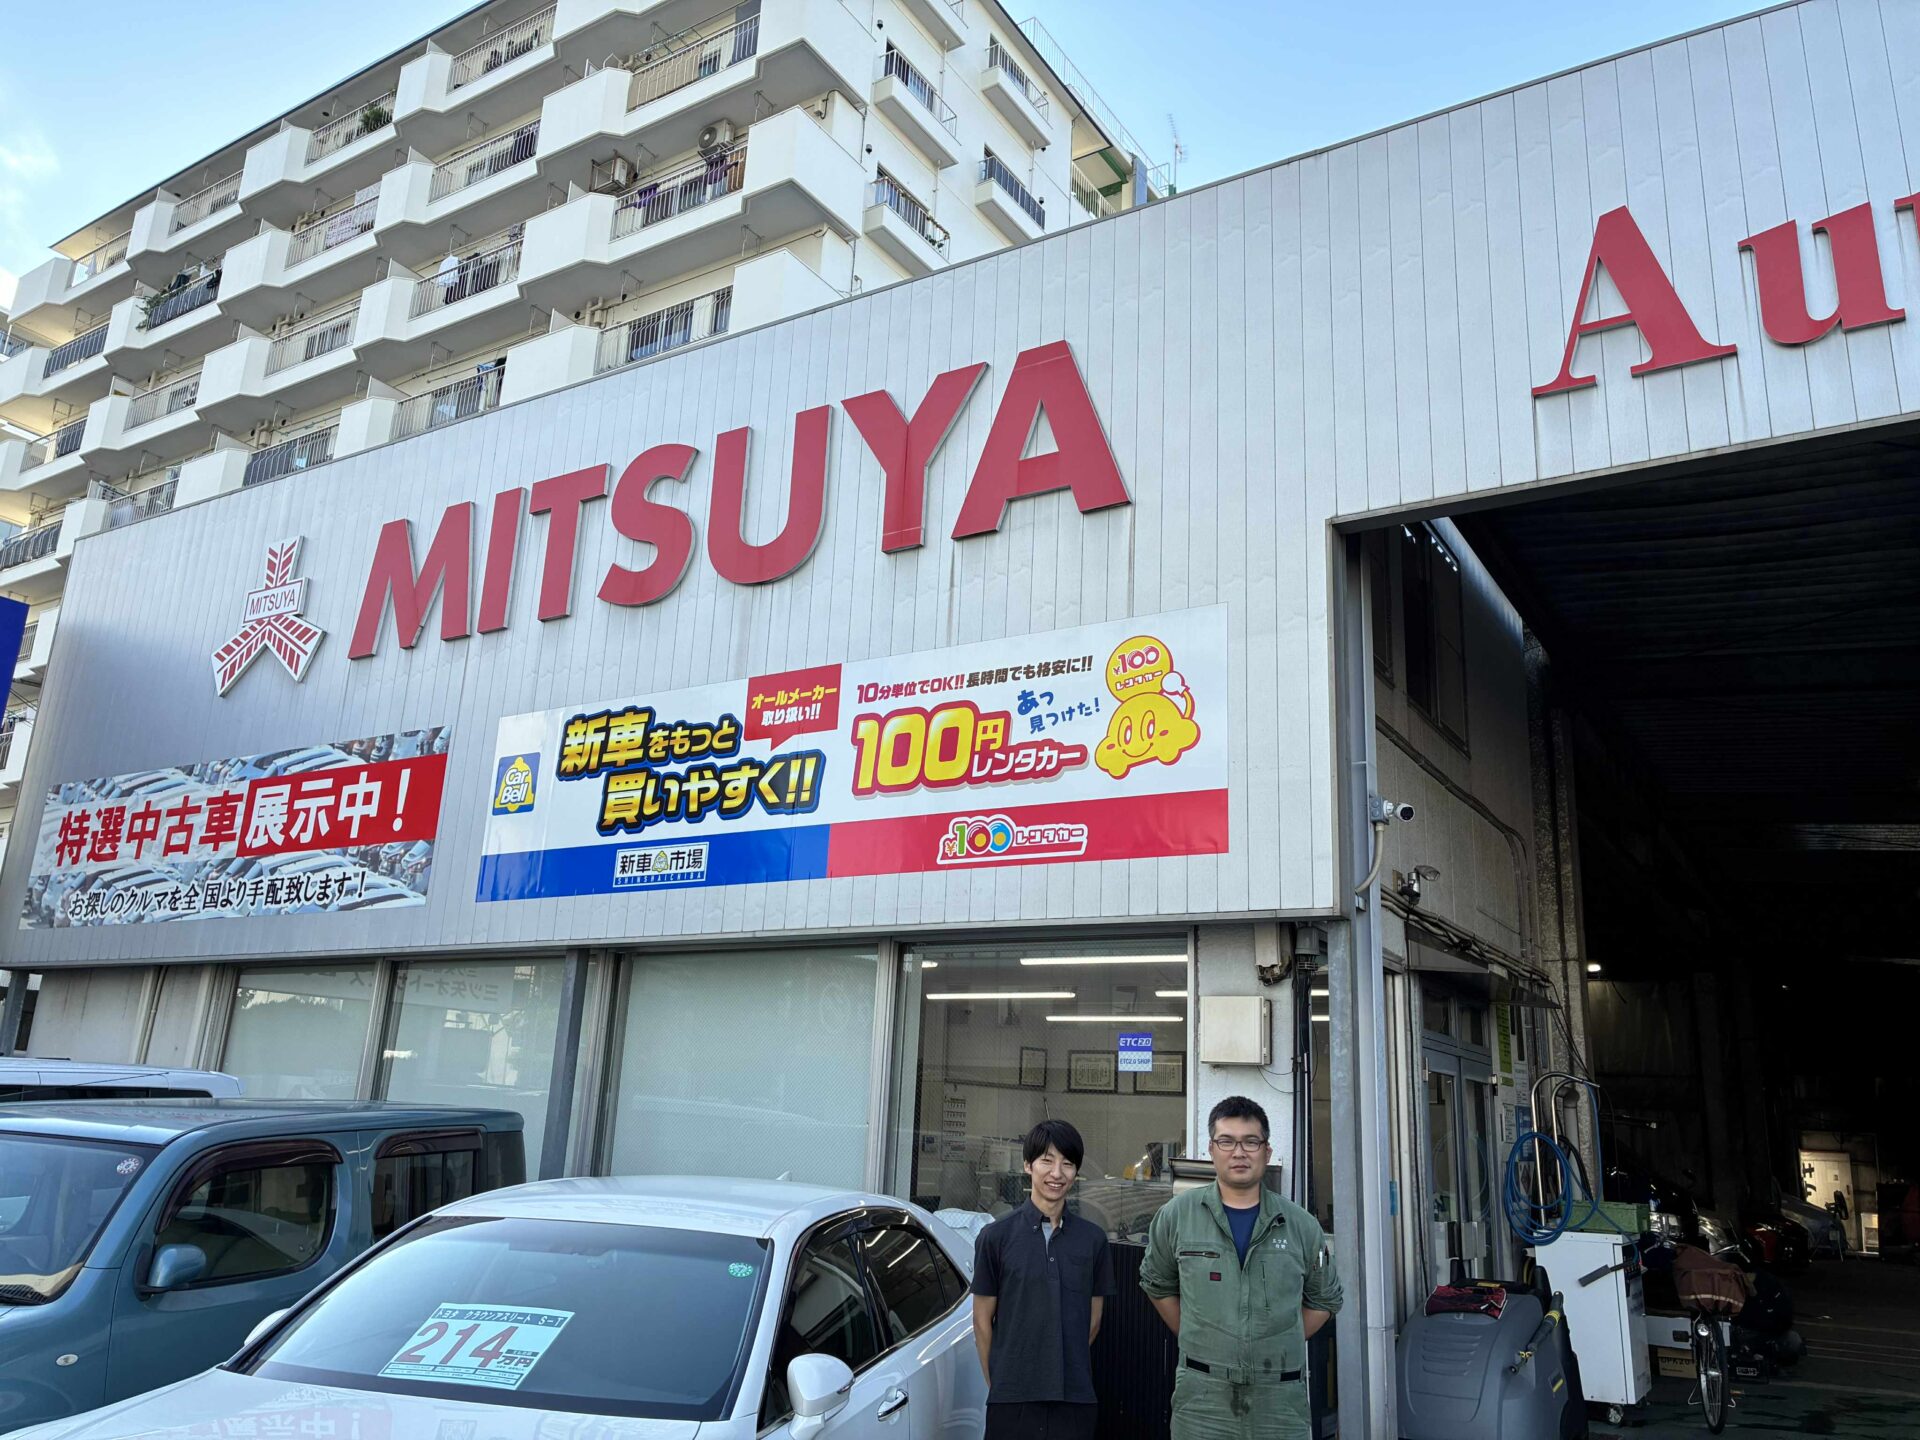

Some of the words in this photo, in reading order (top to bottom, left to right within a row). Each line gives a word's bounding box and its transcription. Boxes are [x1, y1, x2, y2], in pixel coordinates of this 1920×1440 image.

[1532, 191, 1920, 398] Au
[348, 339, 1132, 660] MITSUYA
[249, 588, 296, 616] MITSUYA
[1113, 645, 1160, 675] ¥100
[857, 673, 965, 704] 10分単位でOK!!
[965, 655, 1094, 689] 長時間でも格安に!!
[1114, 670, 1164, 691] レンタカー
[751, 684, 838, 709] オールメーカー
[1016, 688, 1055, 716] あっ
[761, 702, 822, 726] 取り扱い!!
[1028, 697, 1102, 734] 見つけた！
[559, 711, 739, 774] 新車をもっと
[856, 707, 1006, 790] 100円
[505, 768, 529, 785] Car
[971, 748, 1082, 778] レンタカー
[500, 783, 529, 804] Bell
[602, 756, 820, 827] 買いやすく!!
[55, 766, 412, 868] 特選中古車展示中！
[945, 821, 1013, 856] ¥100
[1015, 827, 1085, 845] レンタカー
[616, 871, 702, 885] SHINSHAICHIBA
[67, 870, 366, 920] お探しのクルマを全国より手配致します！
[437, 1309, 459, 1319] トヨタ
[464, 1311, 531, 1325] クラウンアスリート
[538, 1315, 565, 1327] S-T
[394, 1321, 519, 1368] 214
[496, 1355, 535, 1368] 万円
